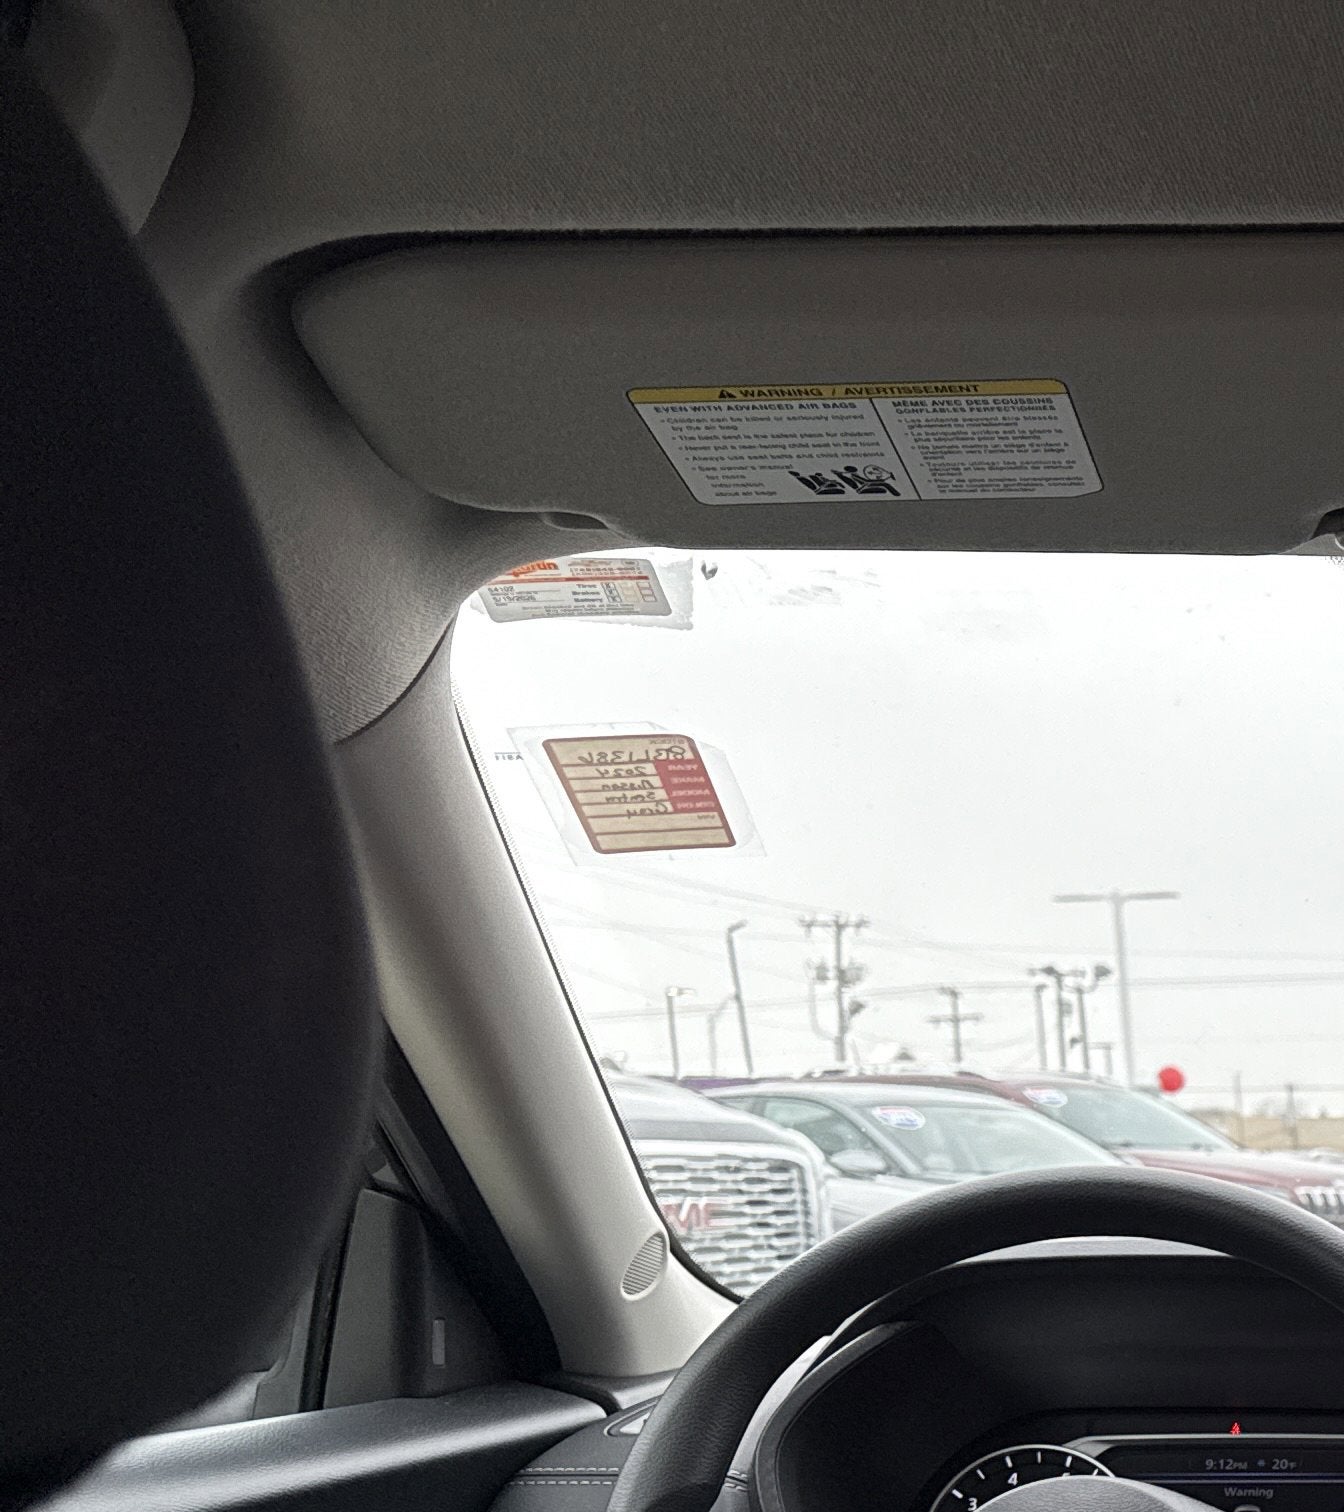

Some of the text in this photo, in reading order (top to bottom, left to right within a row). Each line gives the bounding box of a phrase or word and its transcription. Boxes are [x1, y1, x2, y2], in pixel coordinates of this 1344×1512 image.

[740, 388, 822, 398] WARNING
[844, 384, 980, 396] AVERTISSEMENT
[691, 405, 723, 413] WITH
[726, 403, 794, 412] ADVANCED
[798, 403, 820, 411] AIR
[822, 402, 857, 410] BAGS
[1007, 1472, 1018, 1485] 4
[1223, 1487, 1274, 1499] Warning
[967, 1497, 978, 1511] 3
